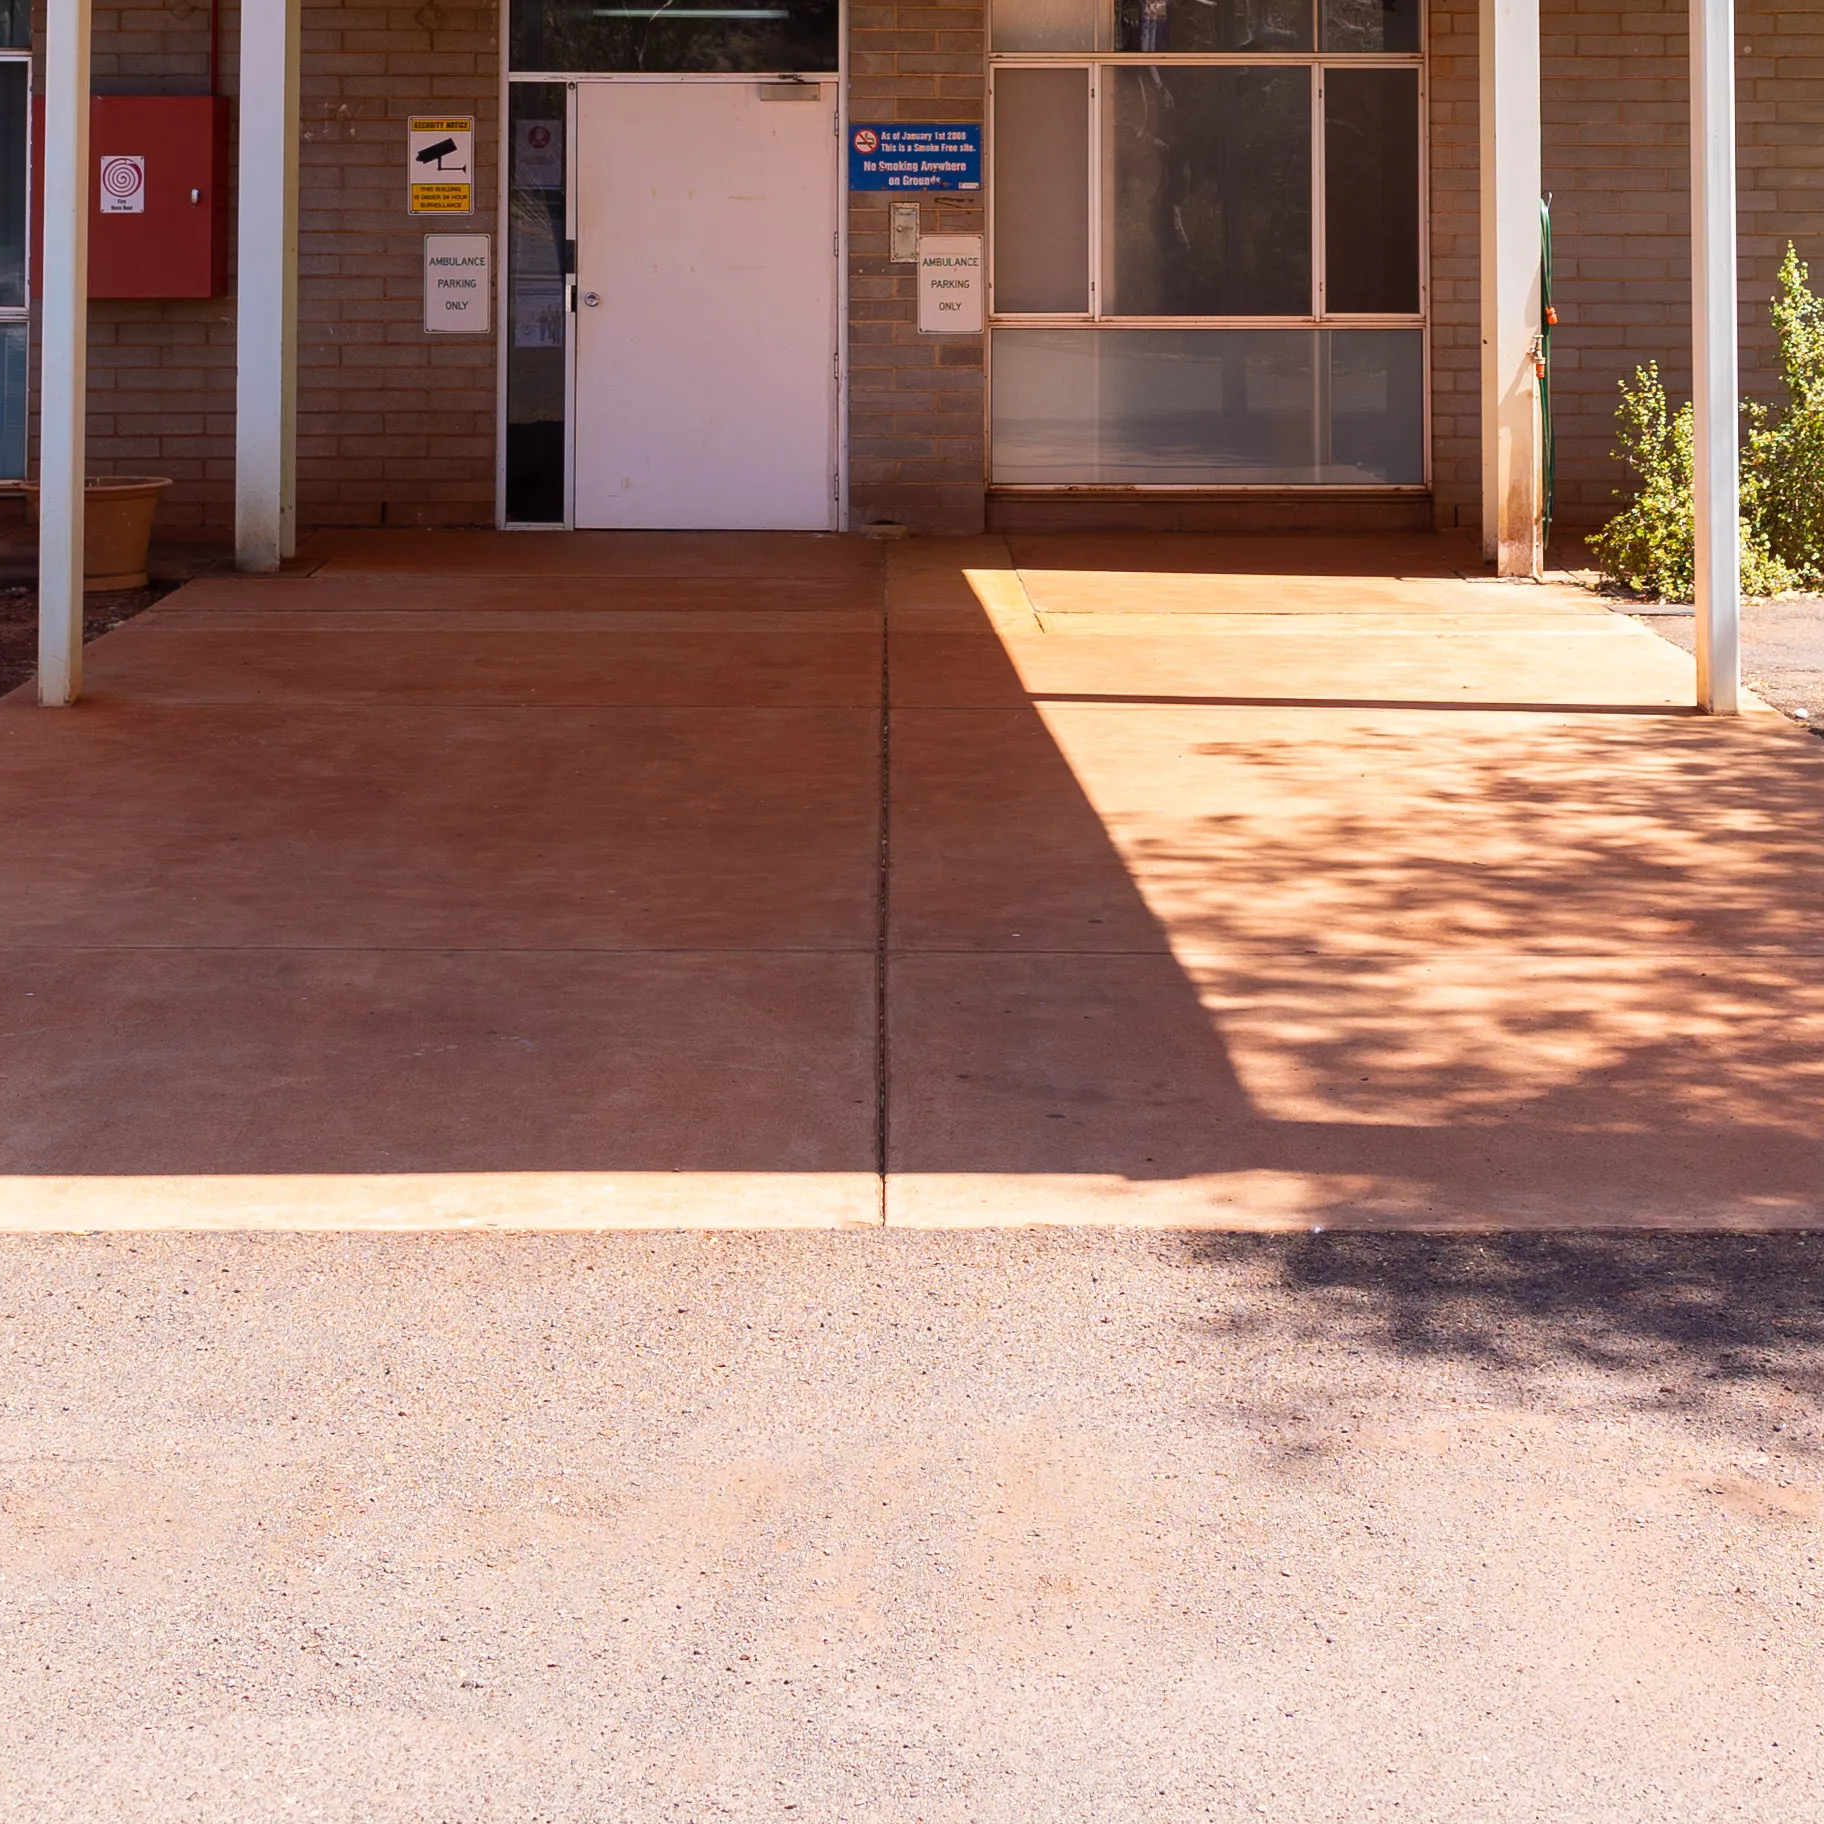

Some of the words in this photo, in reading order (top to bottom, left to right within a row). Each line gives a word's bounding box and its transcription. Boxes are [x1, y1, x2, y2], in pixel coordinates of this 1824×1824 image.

[881, 131, 891, 141] As
[892, 131, 900, 141] of
[902, 131, 933, 142] January
[881, 143, 897, 152] This
[898, 143, 906, 152] is
[914, 143, 940, 152] Smoke
[941, 143, 958, 152] Free
[863, 161, 877, 172] No
[878, 161, 918, 172] Smoking
[920, 161, 967, 172] Anywhere
[888, 177, 900, 186] on
[429, 257, 486, 266] AMBULANCE
[922, 258, 979, 267] AMBULANCE
[437, 279, 477, 288] PARKING
[930, 279, 971, 289] PARKING
[445, 301, 468, 310] ONLY
[938, 302, 962, 311] ONLY
